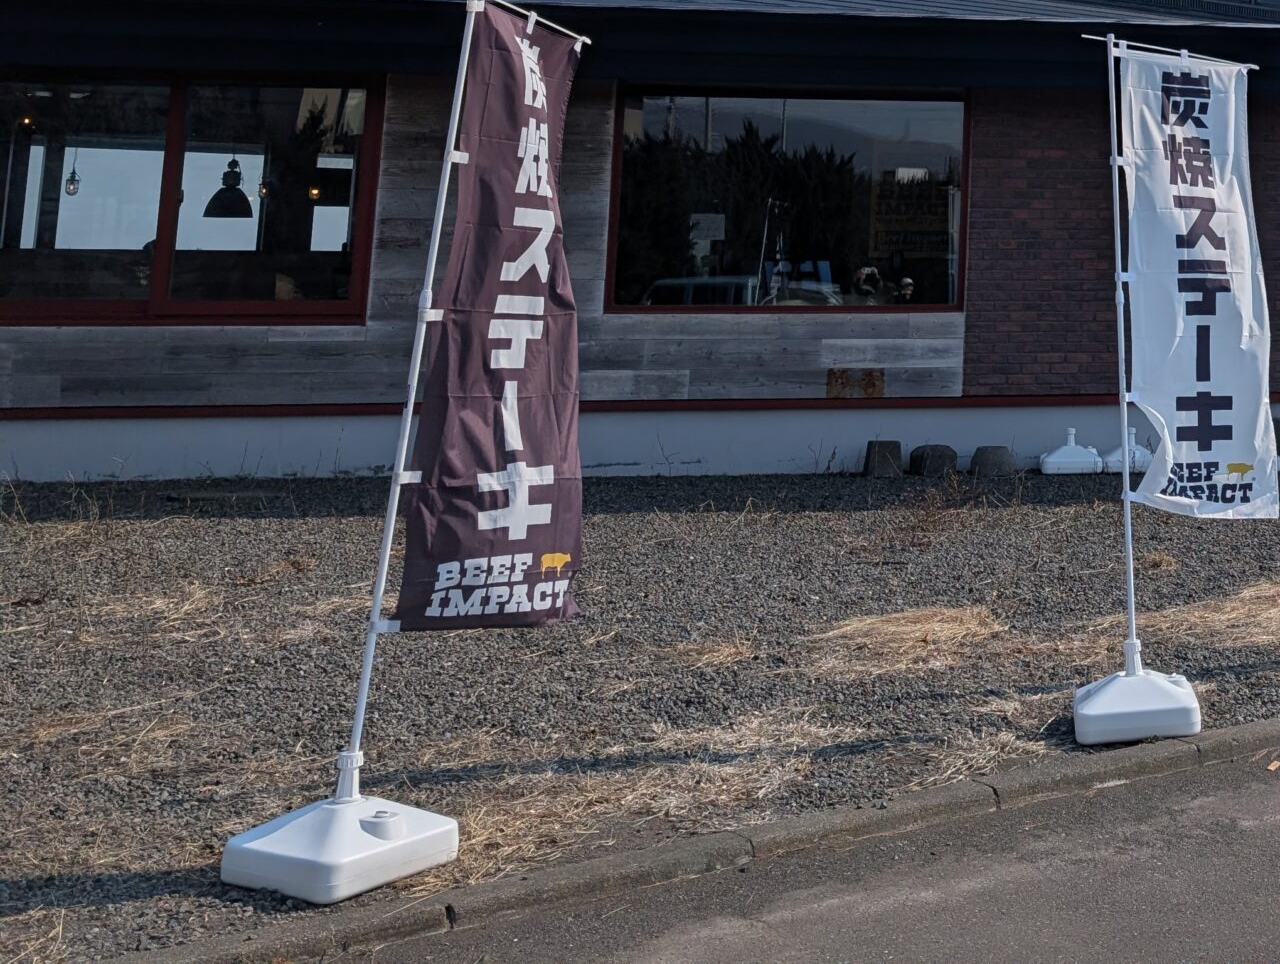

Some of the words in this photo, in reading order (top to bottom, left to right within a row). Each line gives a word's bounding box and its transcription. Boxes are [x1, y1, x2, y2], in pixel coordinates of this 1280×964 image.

[1160, 71, 1233, 452] 炭焼ステーキ
[477, 35, 556, 540] 炭焼ステーキ
[1169, 461, 1220, 483] EEF
[434, 552, 533, 591] BEEF
[424, 579, 570, 618] IMPACT
